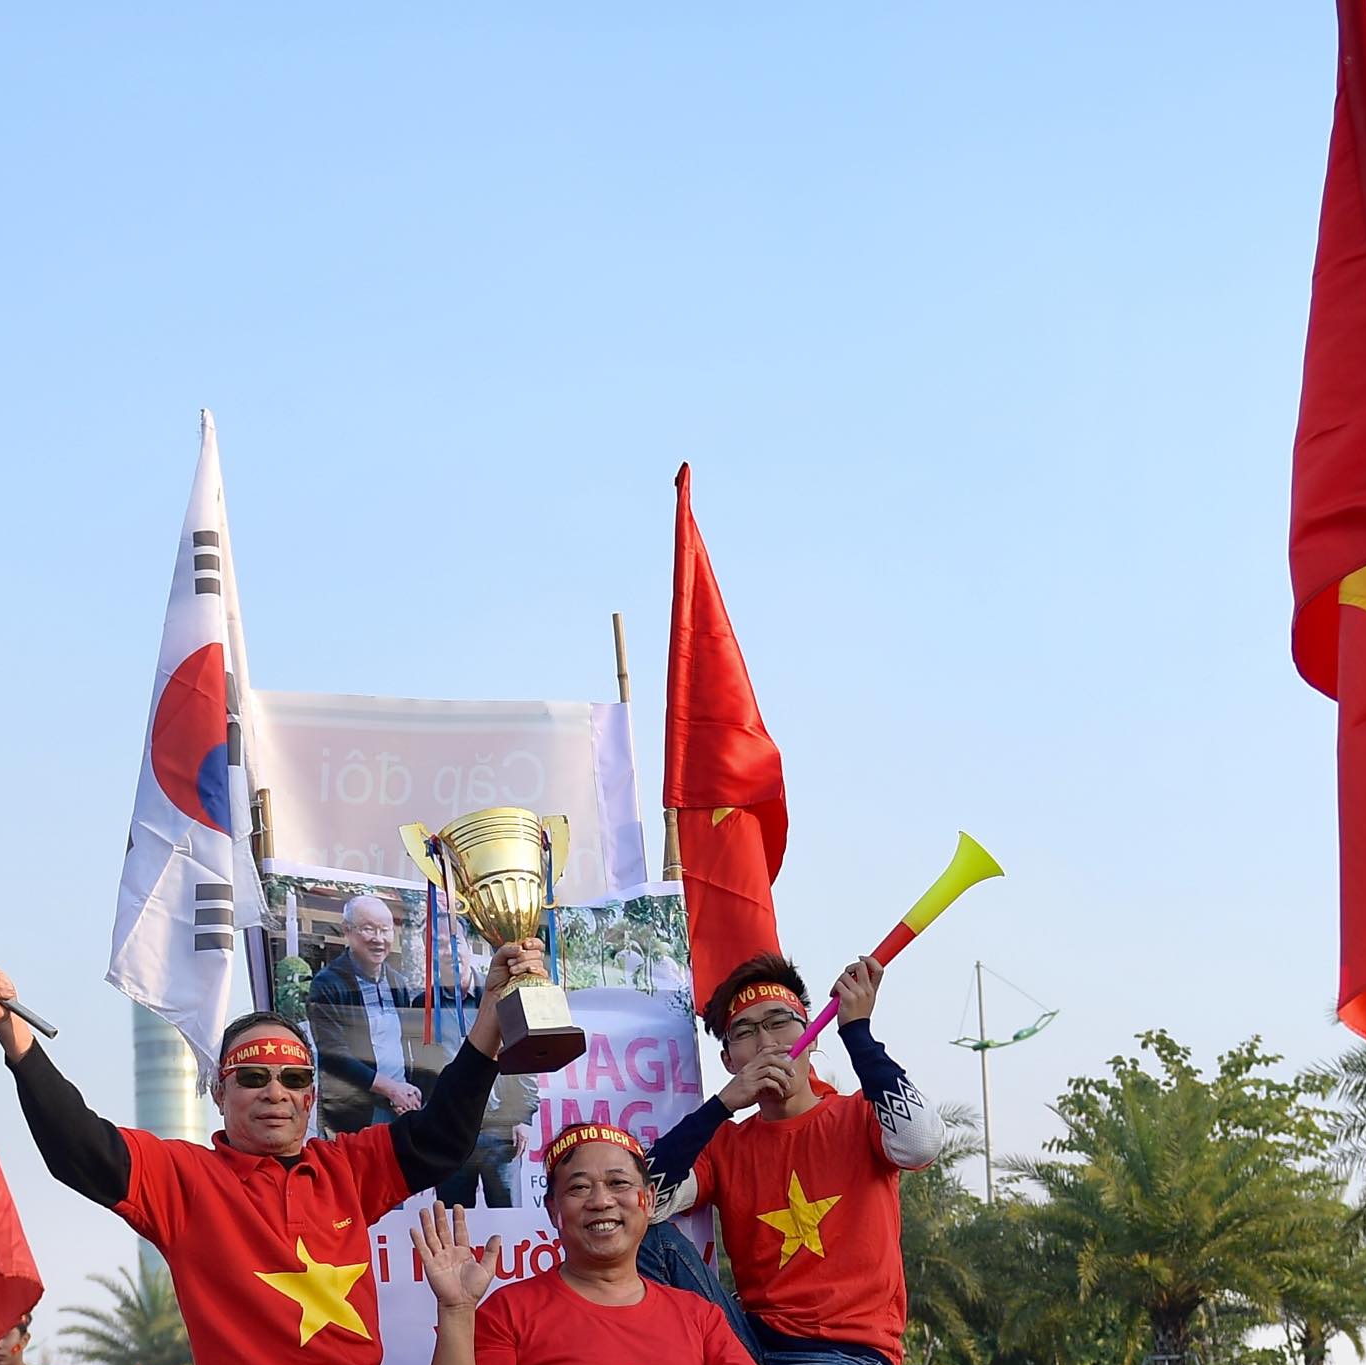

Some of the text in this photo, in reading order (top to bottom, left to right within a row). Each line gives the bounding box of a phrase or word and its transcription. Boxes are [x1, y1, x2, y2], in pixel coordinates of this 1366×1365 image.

[738, 985, 788, 1004] VÔ ĐỊCH
[236, 1045, 260, 1062] NAM
[552, 1132, 578, 1158] NAM
[580, 1126, 598, 1140] VÔ
[601, 1128, 630, 1147] ĐỊCH
